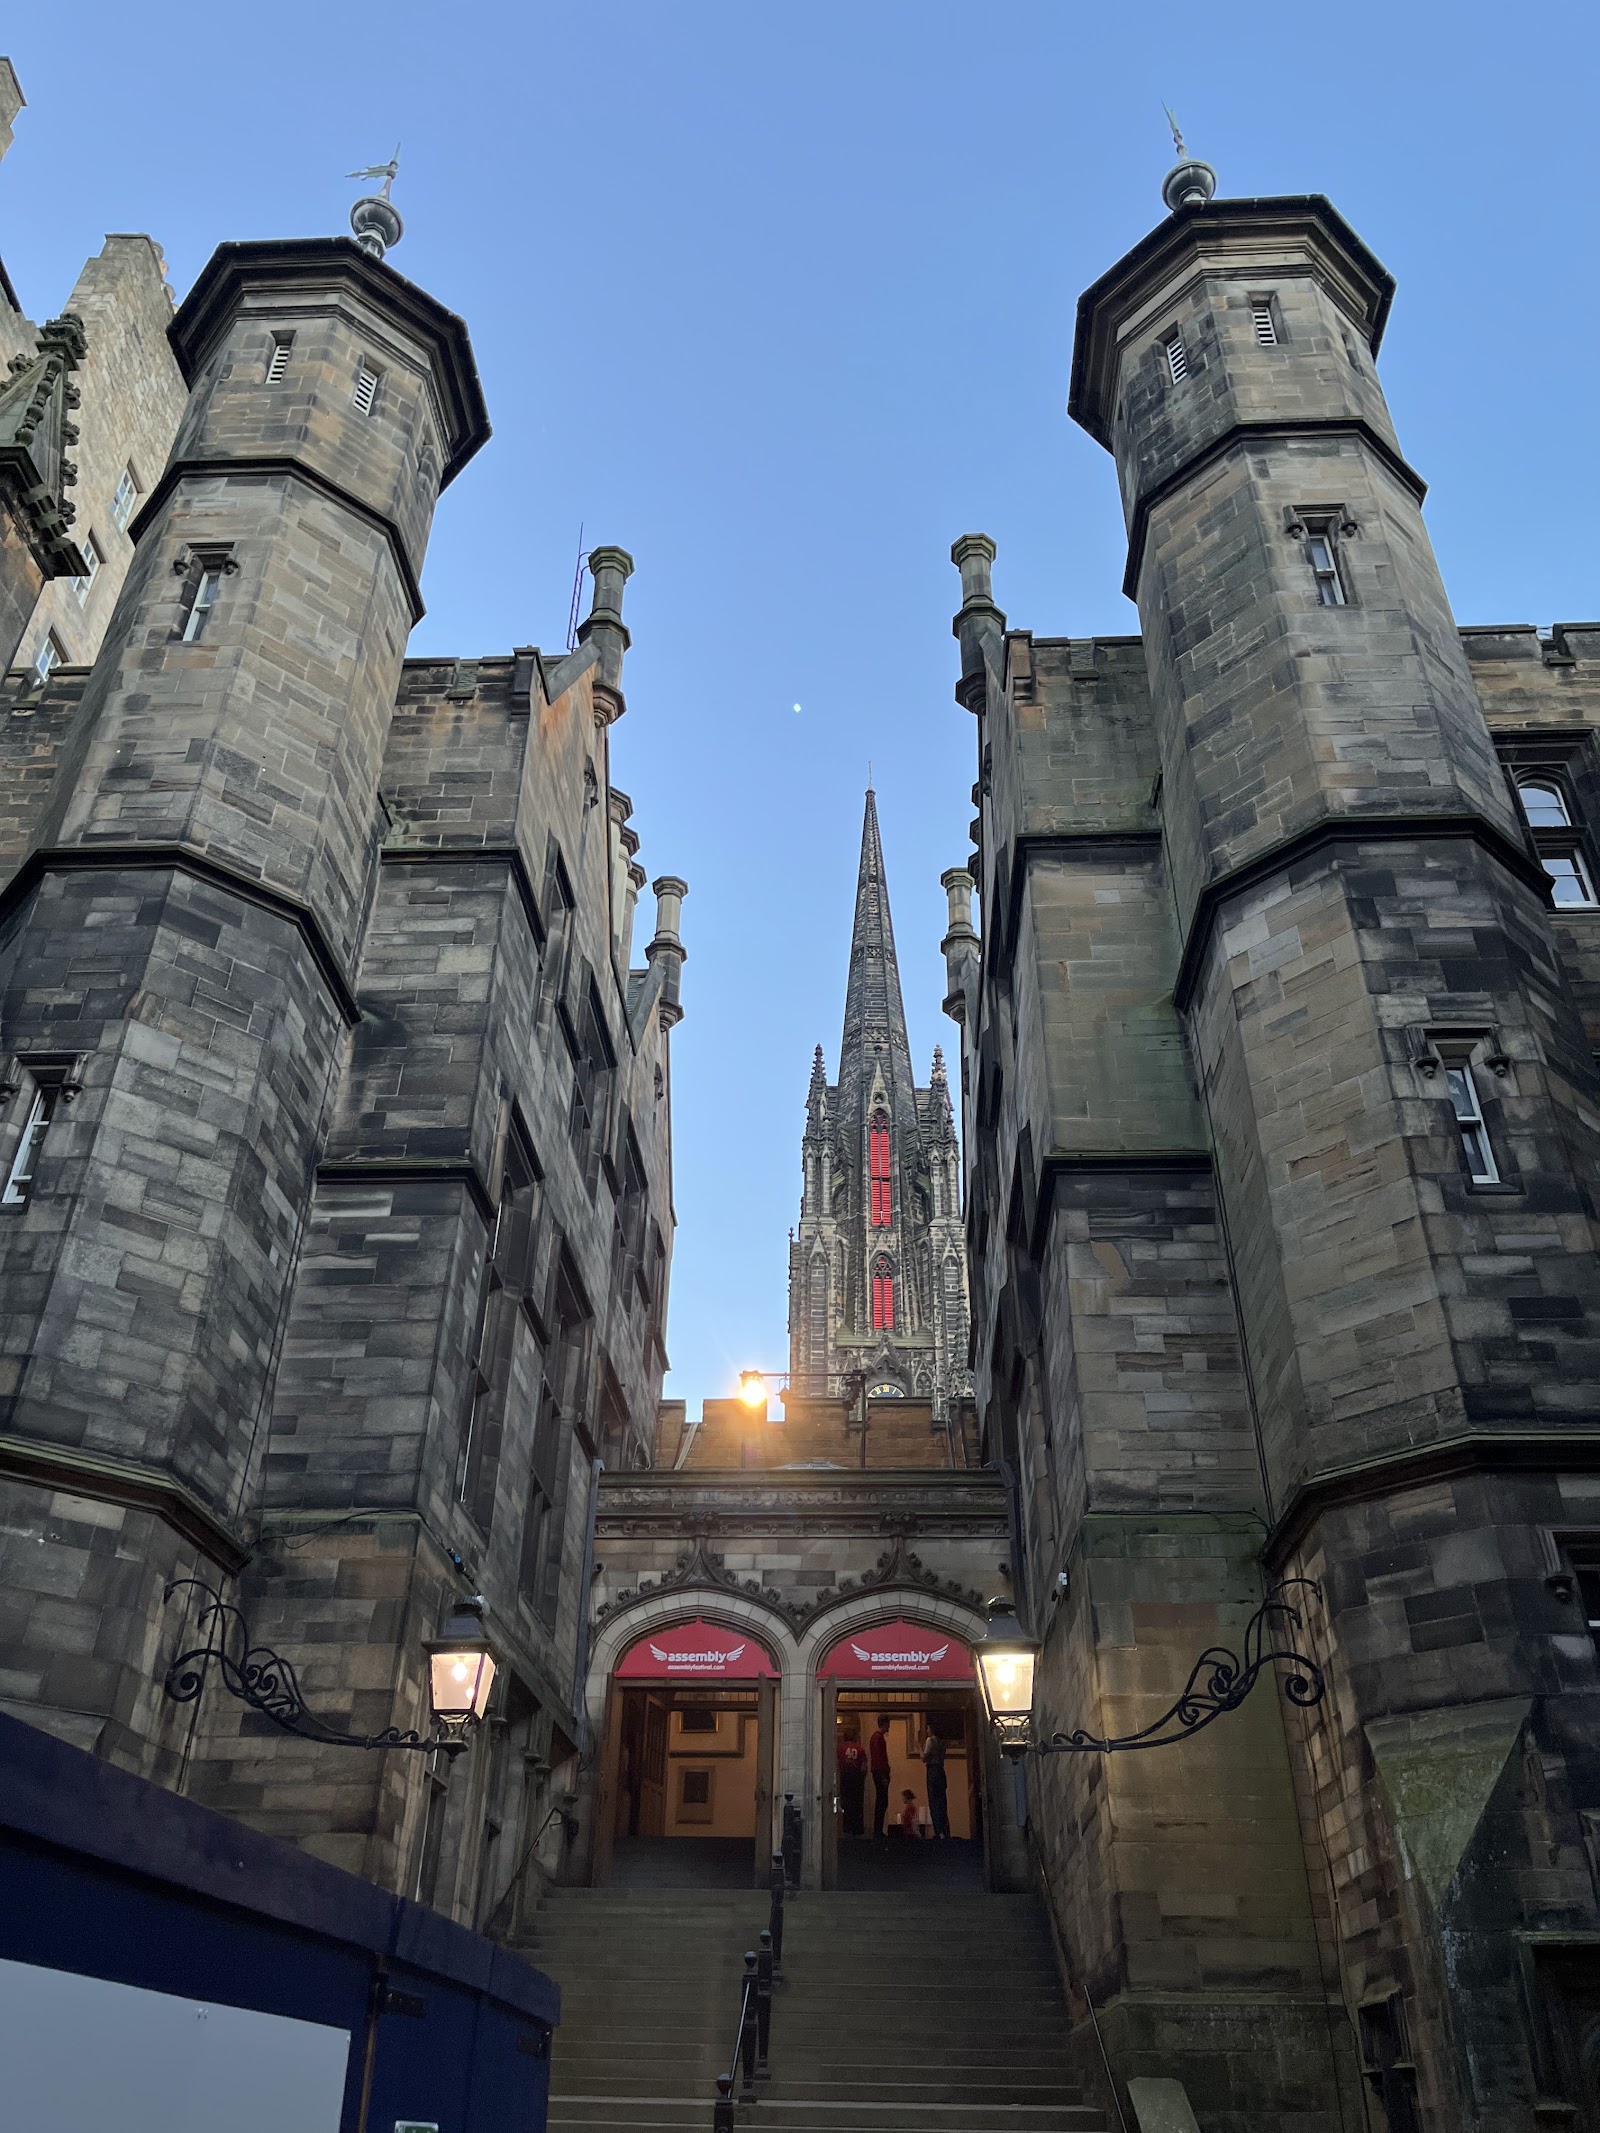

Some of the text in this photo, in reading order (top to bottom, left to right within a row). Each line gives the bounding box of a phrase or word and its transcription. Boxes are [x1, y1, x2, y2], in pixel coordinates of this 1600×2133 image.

[668, 1651, 727, 1664] assembly
[871, 1651, 931, 1664] assembly
[667, 1664, 726, 1672] assemblyfestival.com
[871, 1664, 930, 1672] assemblyfestival.com
[845, 1747, 858, 1760] 40
